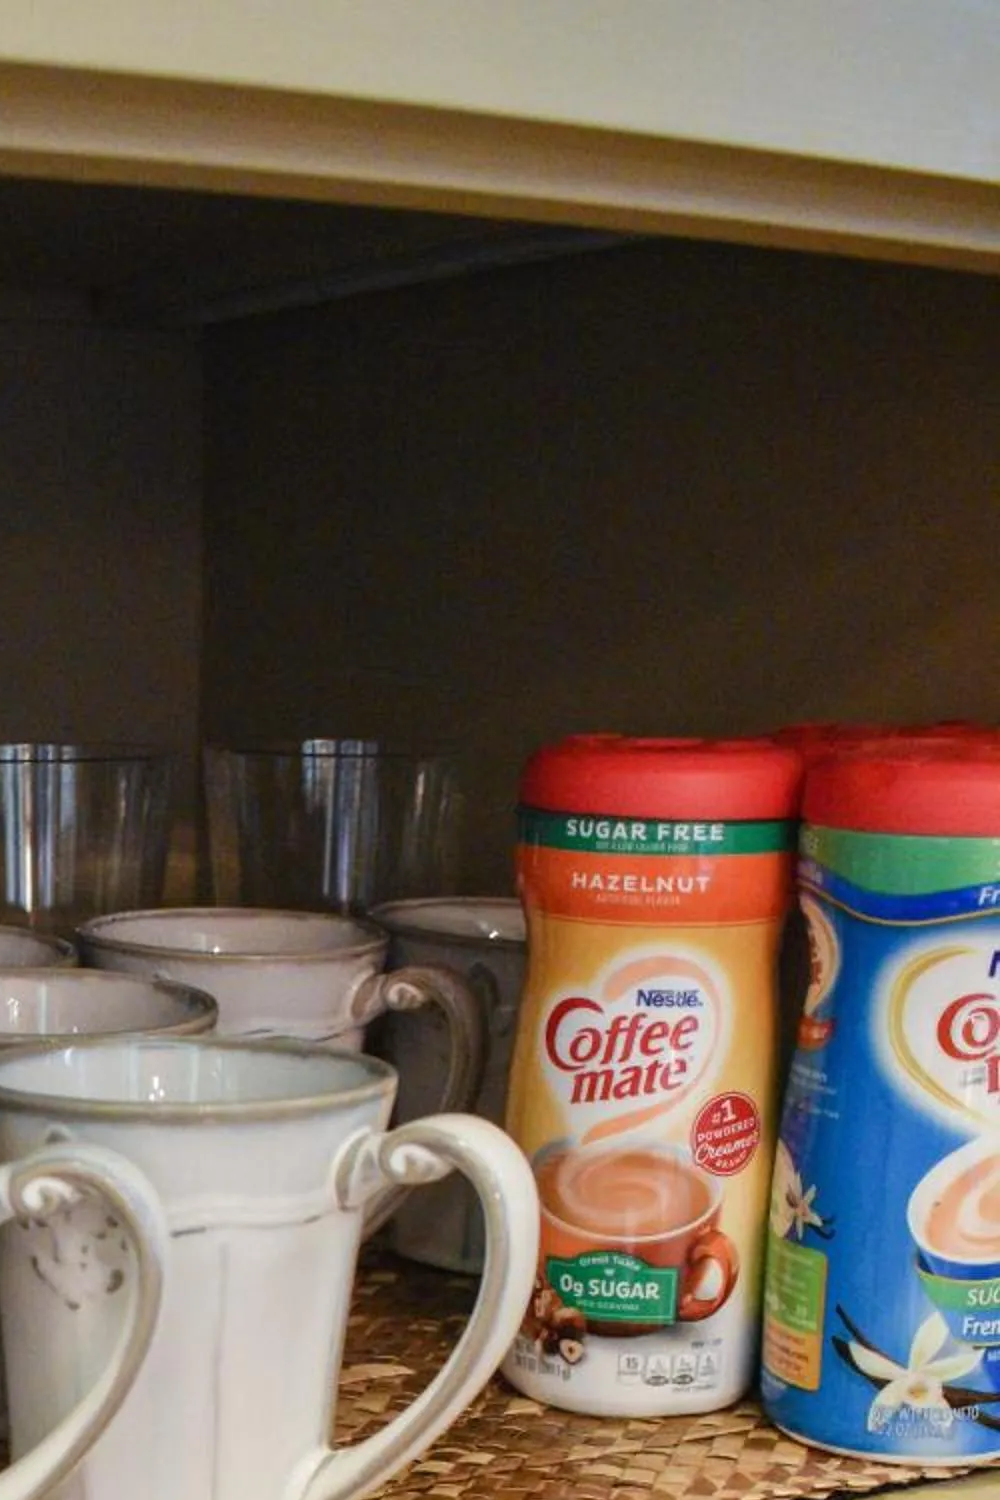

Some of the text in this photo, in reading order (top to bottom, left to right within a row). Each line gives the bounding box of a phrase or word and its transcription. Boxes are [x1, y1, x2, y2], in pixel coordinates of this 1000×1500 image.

[567, 819, 725, 841] SUGAR FREE
[571, 872, 711, 894] HAZELNUT
[545, 997, 699, 1072] Coffee
[570, 1057, 688, 1105] mate
[560, 1273, 660, 1300] 0g SUGAR
